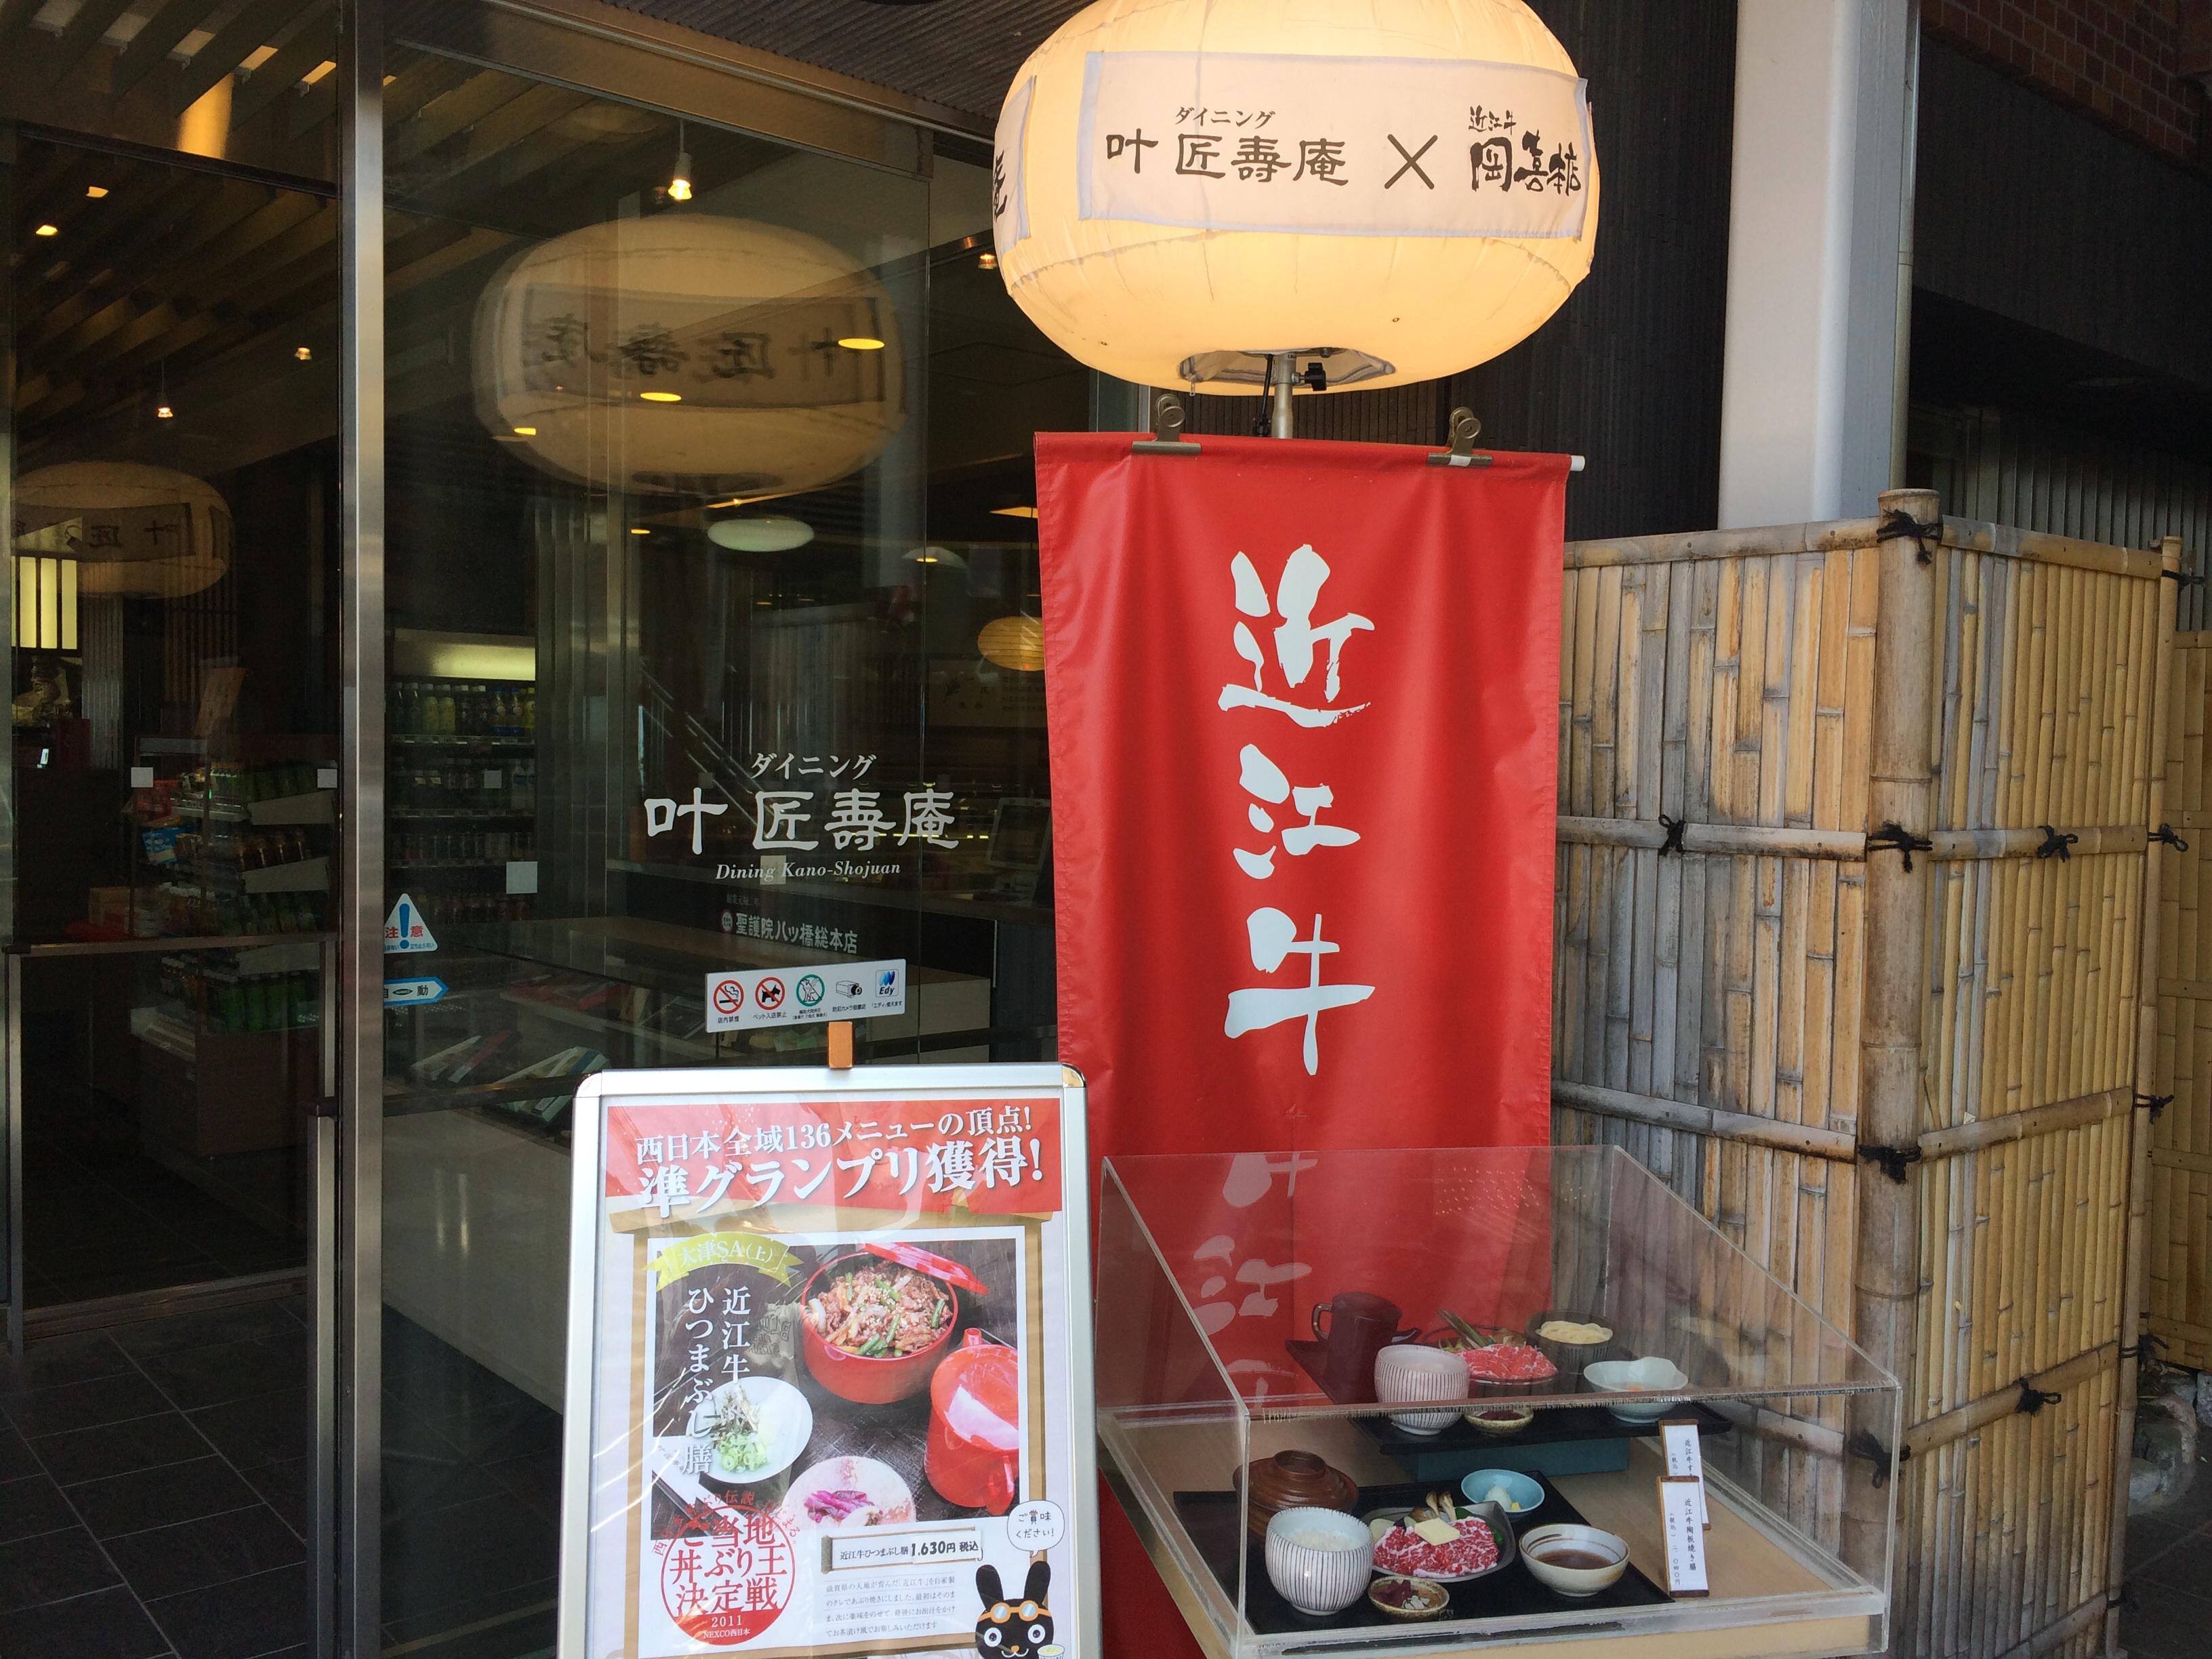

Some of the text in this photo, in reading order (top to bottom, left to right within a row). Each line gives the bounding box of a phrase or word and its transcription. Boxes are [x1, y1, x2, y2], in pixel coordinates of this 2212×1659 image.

[1174, 106, 1277, 131] ダイニング
[750, 752, 877, 780] ダイニング
[1218, 544, 1376, 1076] 近江牛
[715, 861, 901, 880] Dining Kano-Shojuan
[878, 985, 895, 996] Edy
[720, 1286, 752, 1384] 近江牛
[682, 1286, 714, 1475] ひつまぶし膳
[1019, 1509, 1052, 1525] ご賞味
[1016, 1528, 1054, 1538] ください!
[840, 1546, 909, 1561] 近江牛ひつまぶし膳
[959, 1540, 979, 1553] 税込
[669, 1542, 787, 1585] 丼ぶり王
[675, 1576, 779, 1616] 決定戦
[703, 1627, 751, 1639] NEXCO西日本
[711, 1615, 743, 1628] 2011
